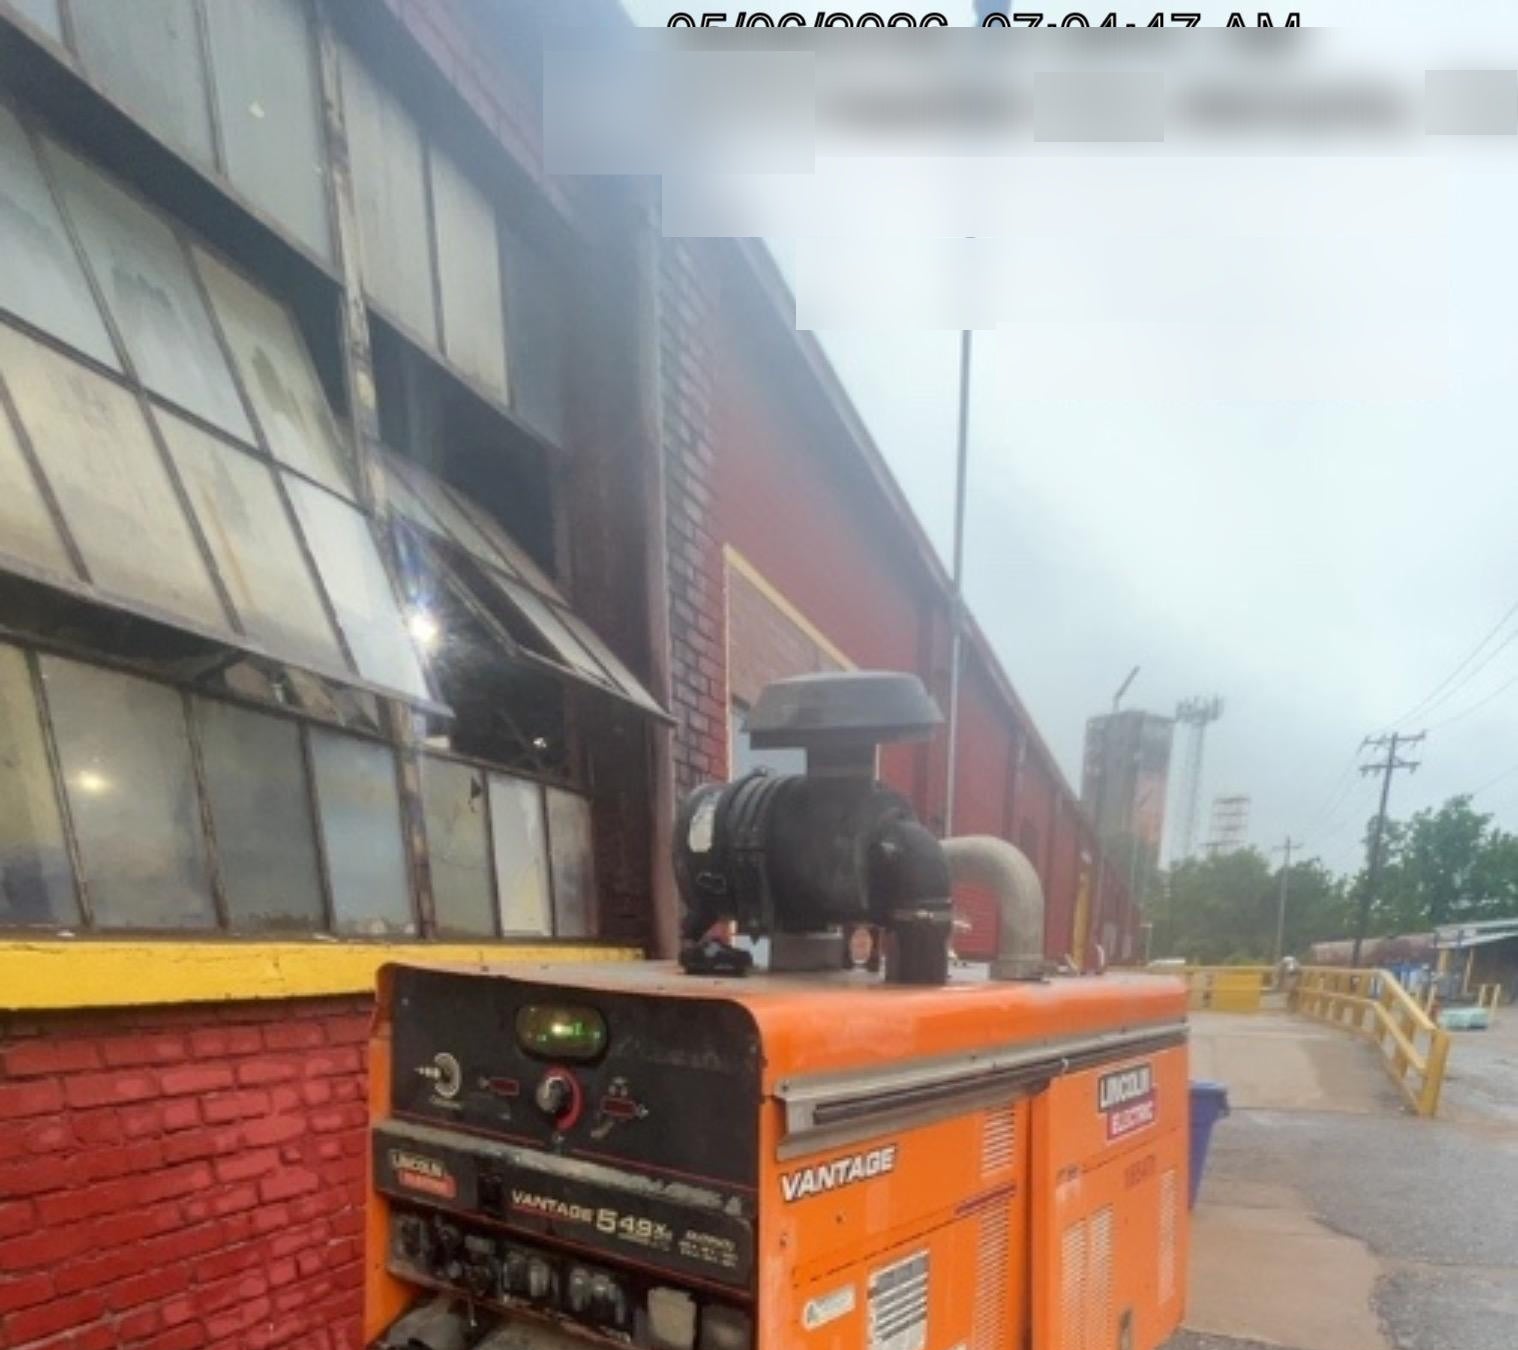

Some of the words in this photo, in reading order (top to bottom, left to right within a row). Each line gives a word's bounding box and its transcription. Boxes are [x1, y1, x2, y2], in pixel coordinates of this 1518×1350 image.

[1100, 1066, 1151, 1109] LINCOLN
[781, 1144, 896, 1202] VANTAGE
[511, 1190, 593, 1222] VANTAGE
